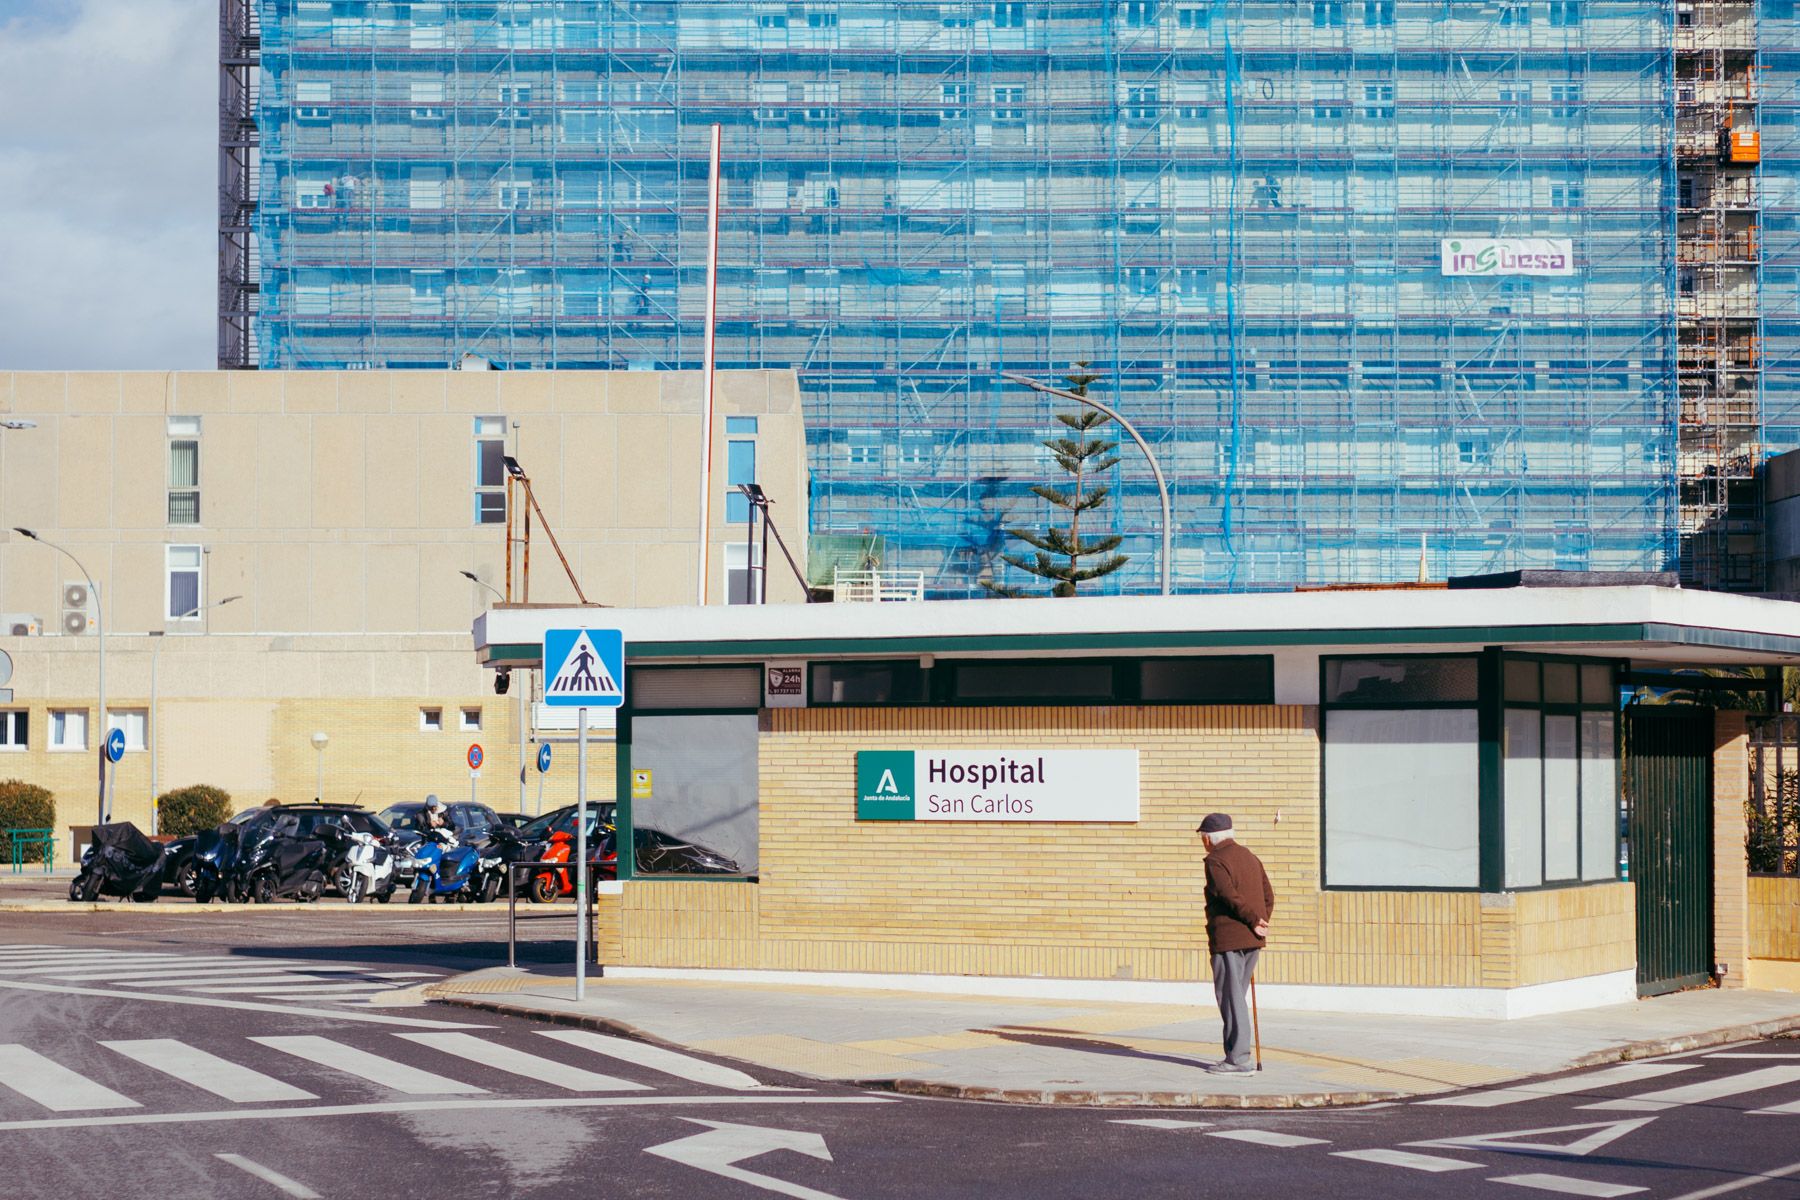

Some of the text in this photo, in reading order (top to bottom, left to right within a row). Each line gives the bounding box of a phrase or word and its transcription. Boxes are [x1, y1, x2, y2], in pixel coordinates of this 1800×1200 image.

[784, 675, 800, 683] 24h
[929, 757, 1045, 789] Hospital
[929, 794, 1034, 813] San Carlos
